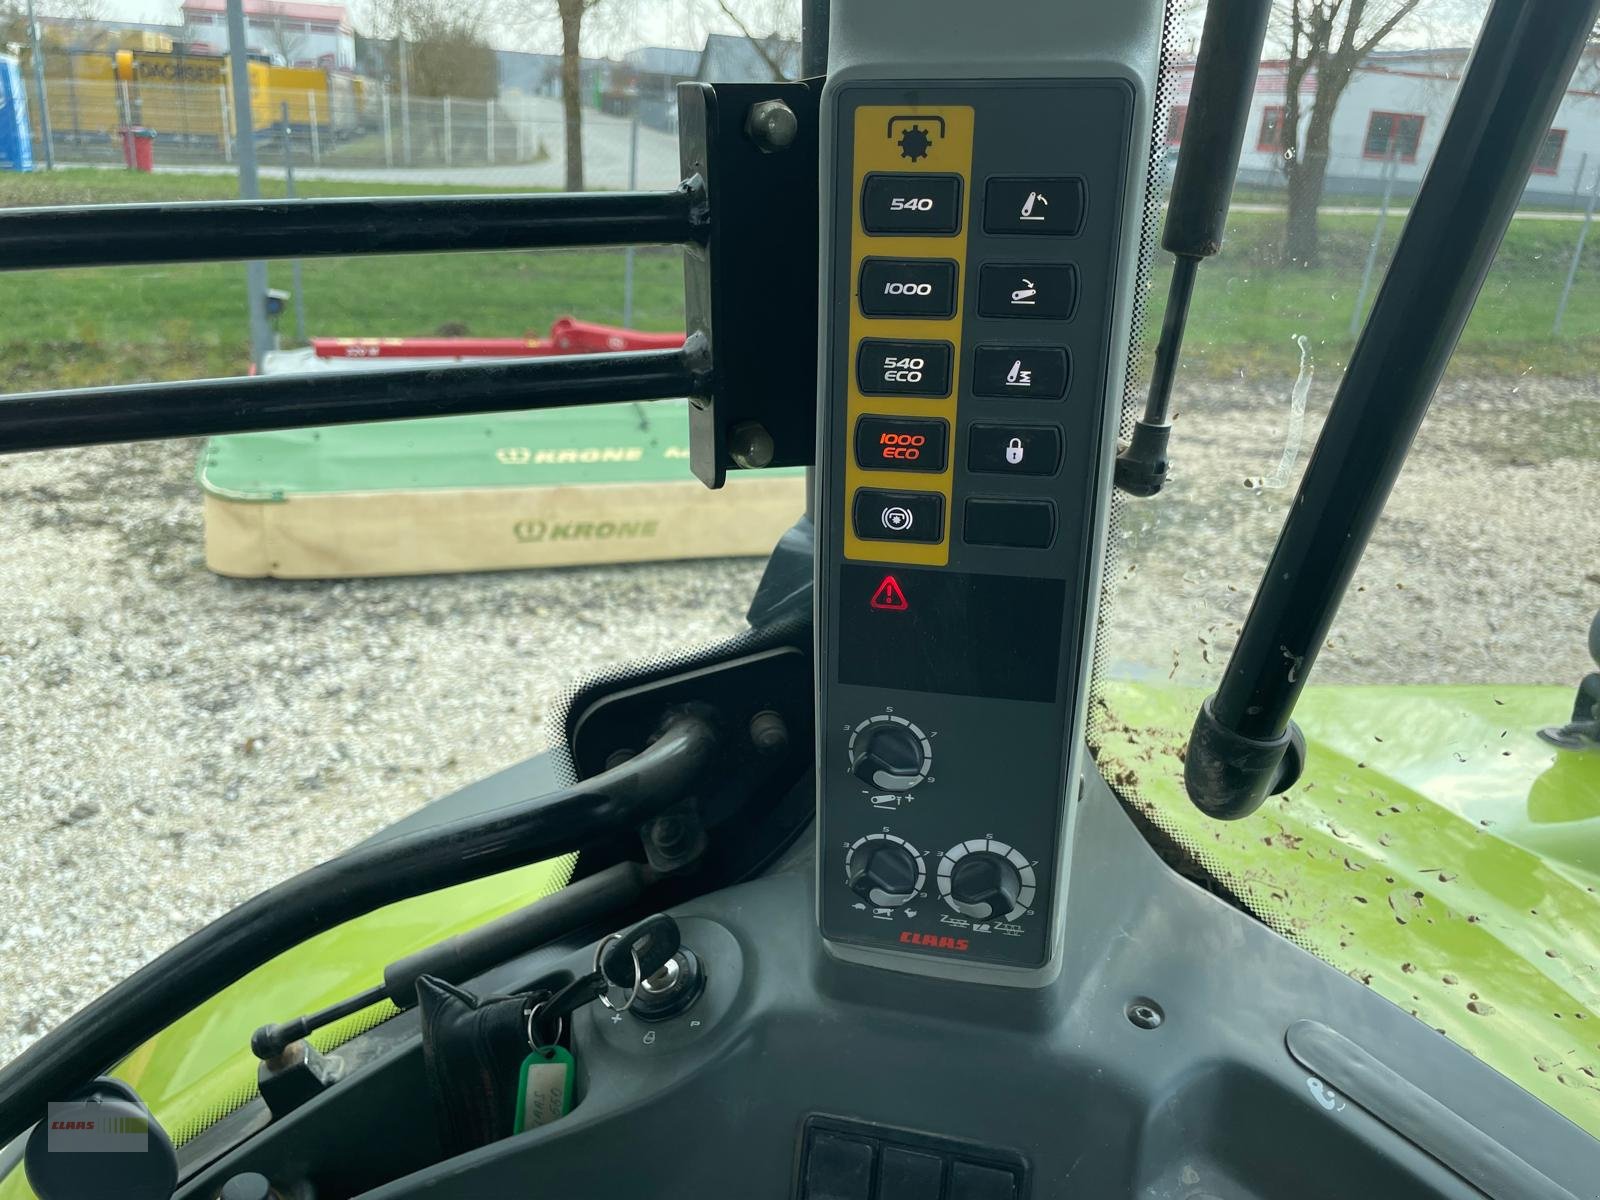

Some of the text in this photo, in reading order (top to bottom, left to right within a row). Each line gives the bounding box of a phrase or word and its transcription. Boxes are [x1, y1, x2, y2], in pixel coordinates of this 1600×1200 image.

[890, 198, 933, 212] 540
[884, 282, 931, 296] 1000
[884, 357, 924, 370] 540
[884, 370, 922, 383] ECO
[879, 433, 925, 446] 1000
[534, 447, 644, 464] KRONE
[882, 447, 920, 460] ECO
[551, 520, 660, 541] KRONE
[900, 931, 969, 951] CLAAS
